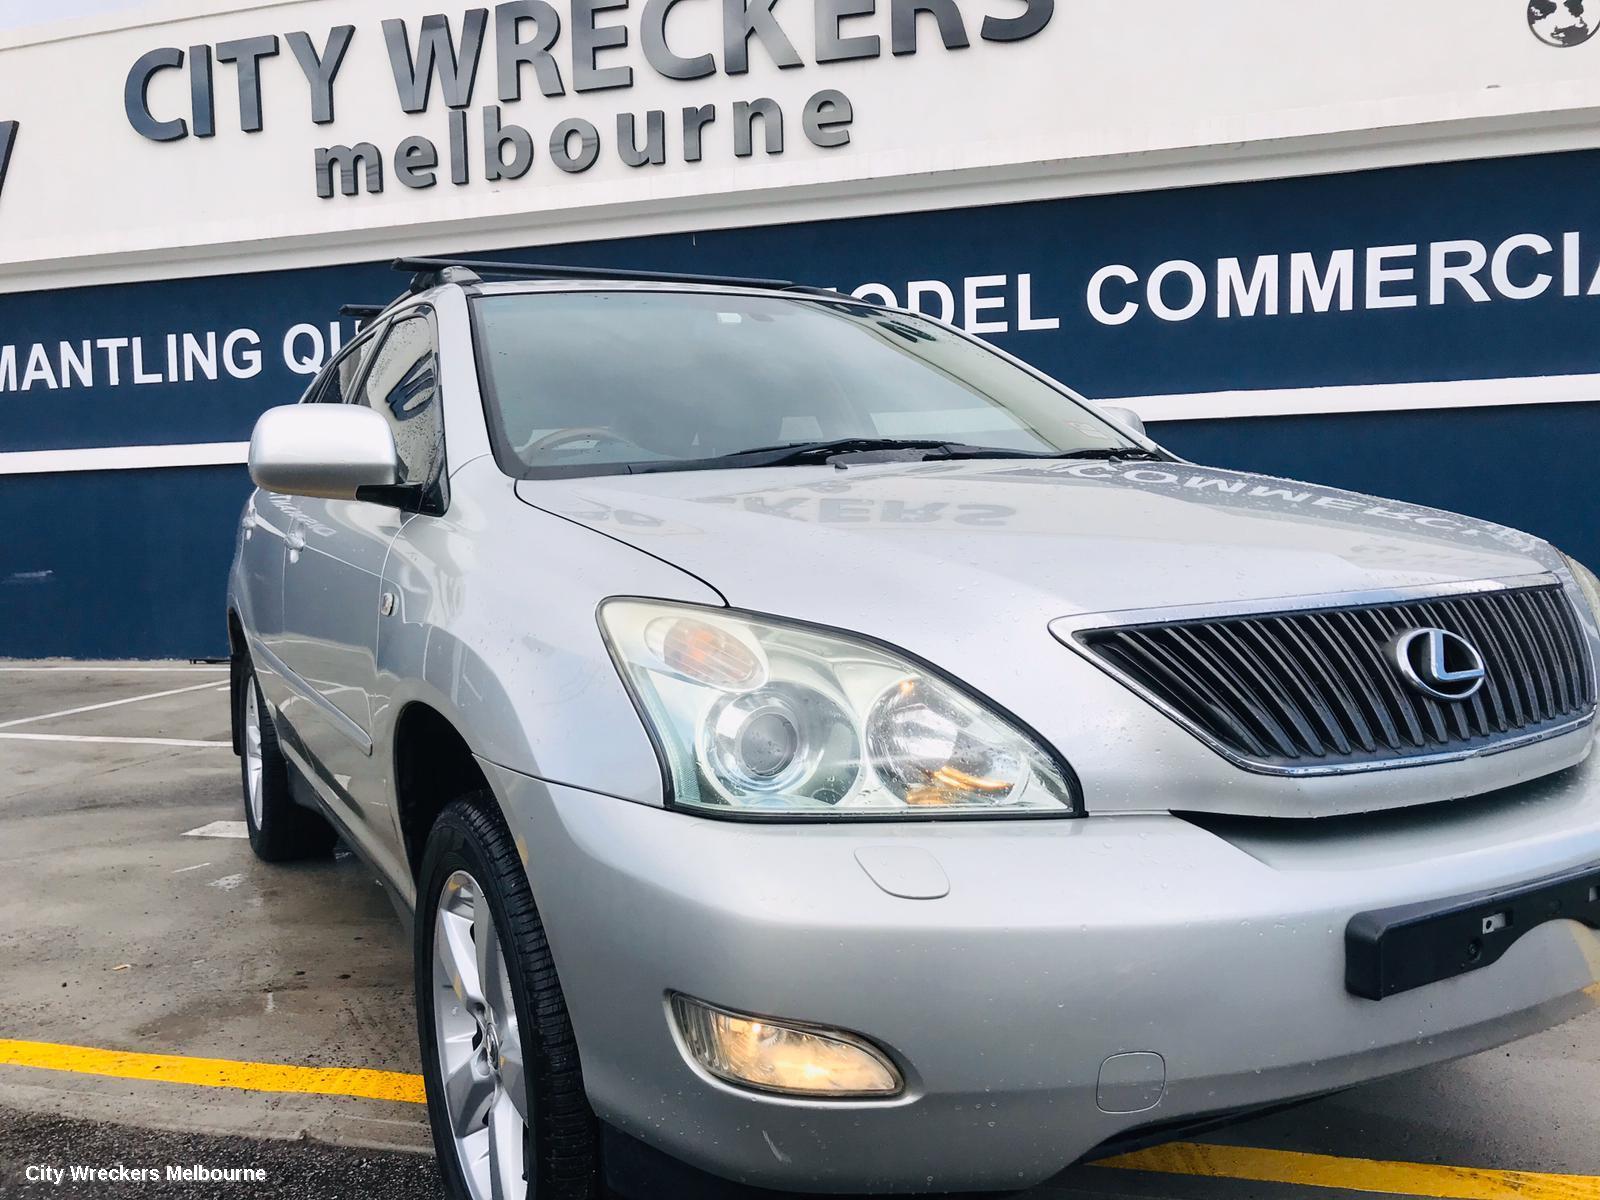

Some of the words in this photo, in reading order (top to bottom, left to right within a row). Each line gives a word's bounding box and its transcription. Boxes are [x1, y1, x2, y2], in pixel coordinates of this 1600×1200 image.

[124, 24, 355, 142] CITY
[314, 88, 853, 199] melbourne
[1086, 231, 1600, 326] COMMERCI
